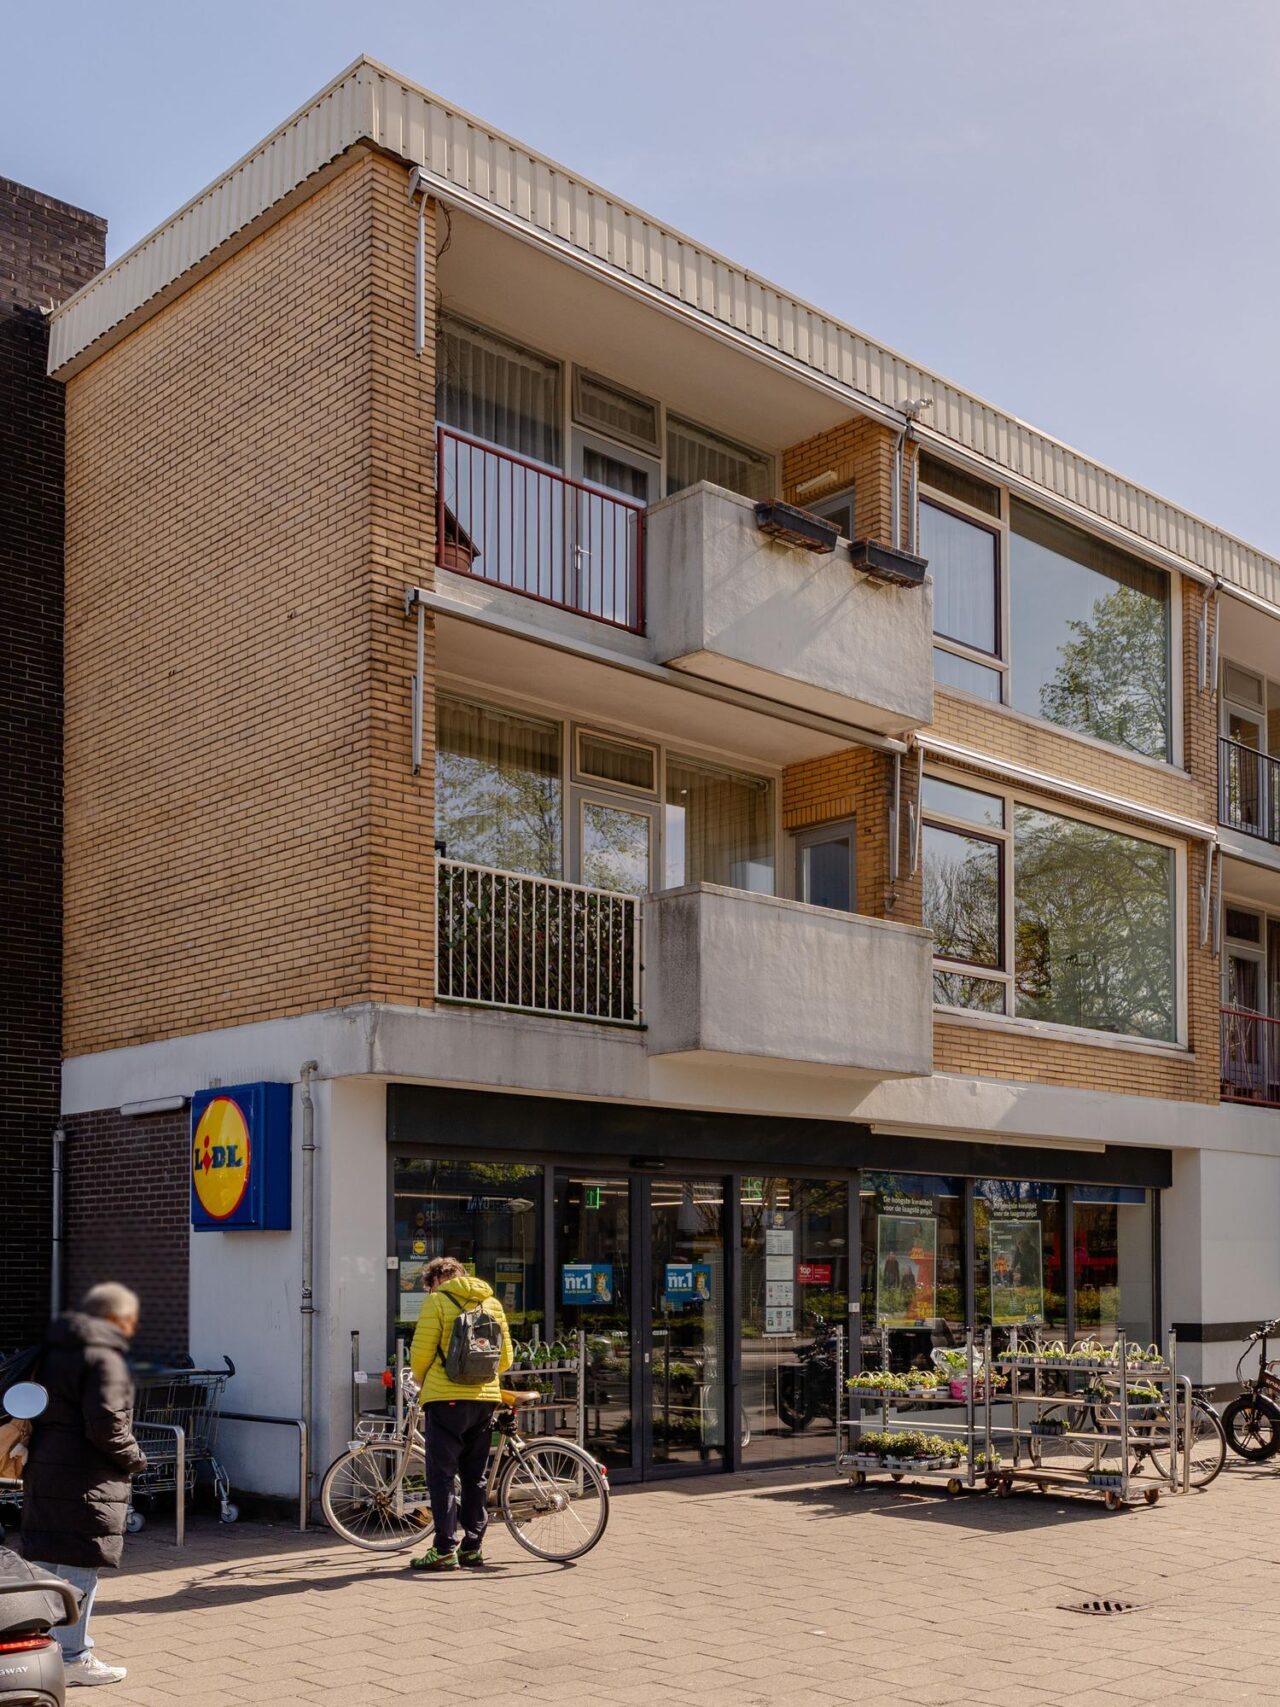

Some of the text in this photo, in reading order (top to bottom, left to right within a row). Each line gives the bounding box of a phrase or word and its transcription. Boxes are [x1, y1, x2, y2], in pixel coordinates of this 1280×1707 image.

[891, 1196, 911, 1205] hoogste
[912, 1198, 933, 1206] kwaliteit
[902, 1206, 920, 1215] laagste
[564, 1273, 592, 1289] nr.1
[667, 1272, 692, 1288] nr.1
